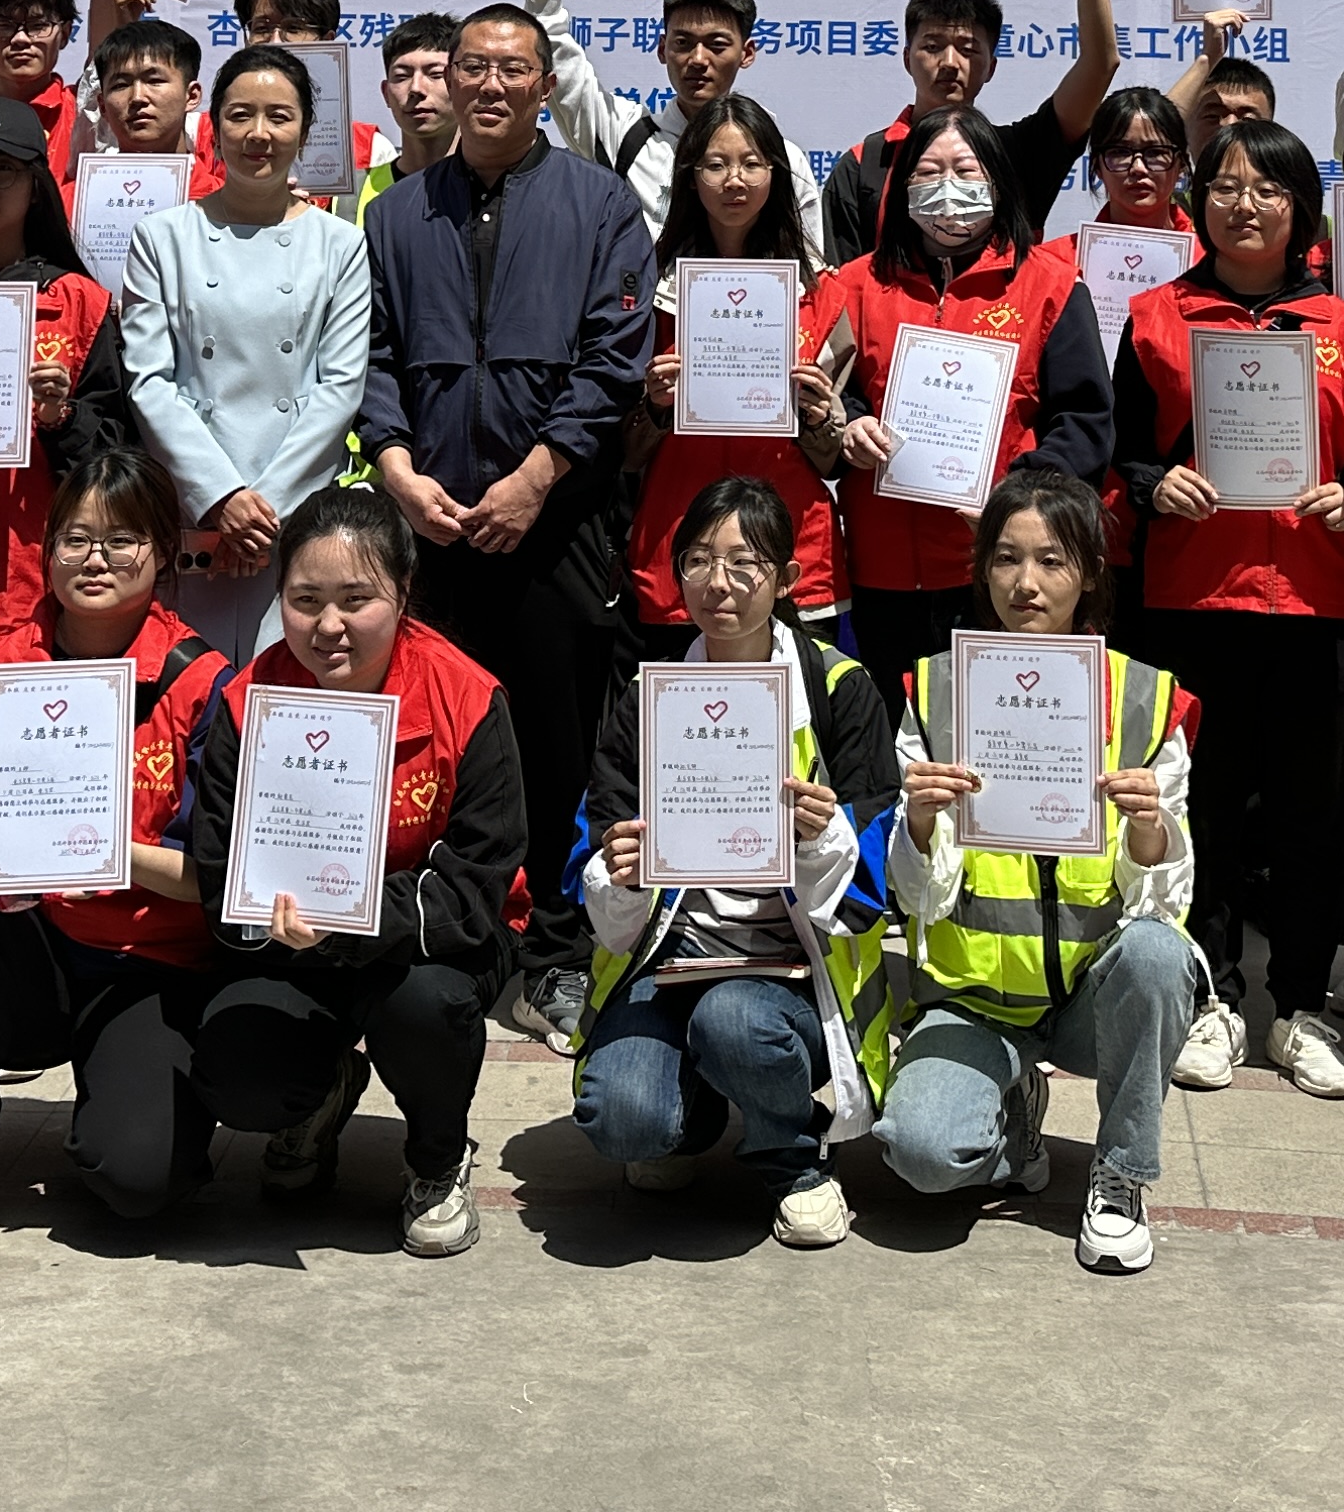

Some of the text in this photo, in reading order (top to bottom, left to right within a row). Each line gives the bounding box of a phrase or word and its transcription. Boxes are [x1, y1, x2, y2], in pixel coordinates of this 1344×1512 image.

[709, 307, 765, 321] 志愿者证书
[1223, 380, 1280, 393] 志愿者证书
[995, 694, 1062, 710] 志愿者证书
[20, 725, 89, 741] 志愿者证书
[683, 726, 750, 740] 志愿者证书
[282, 754, 349, 773] 志愿者证书
